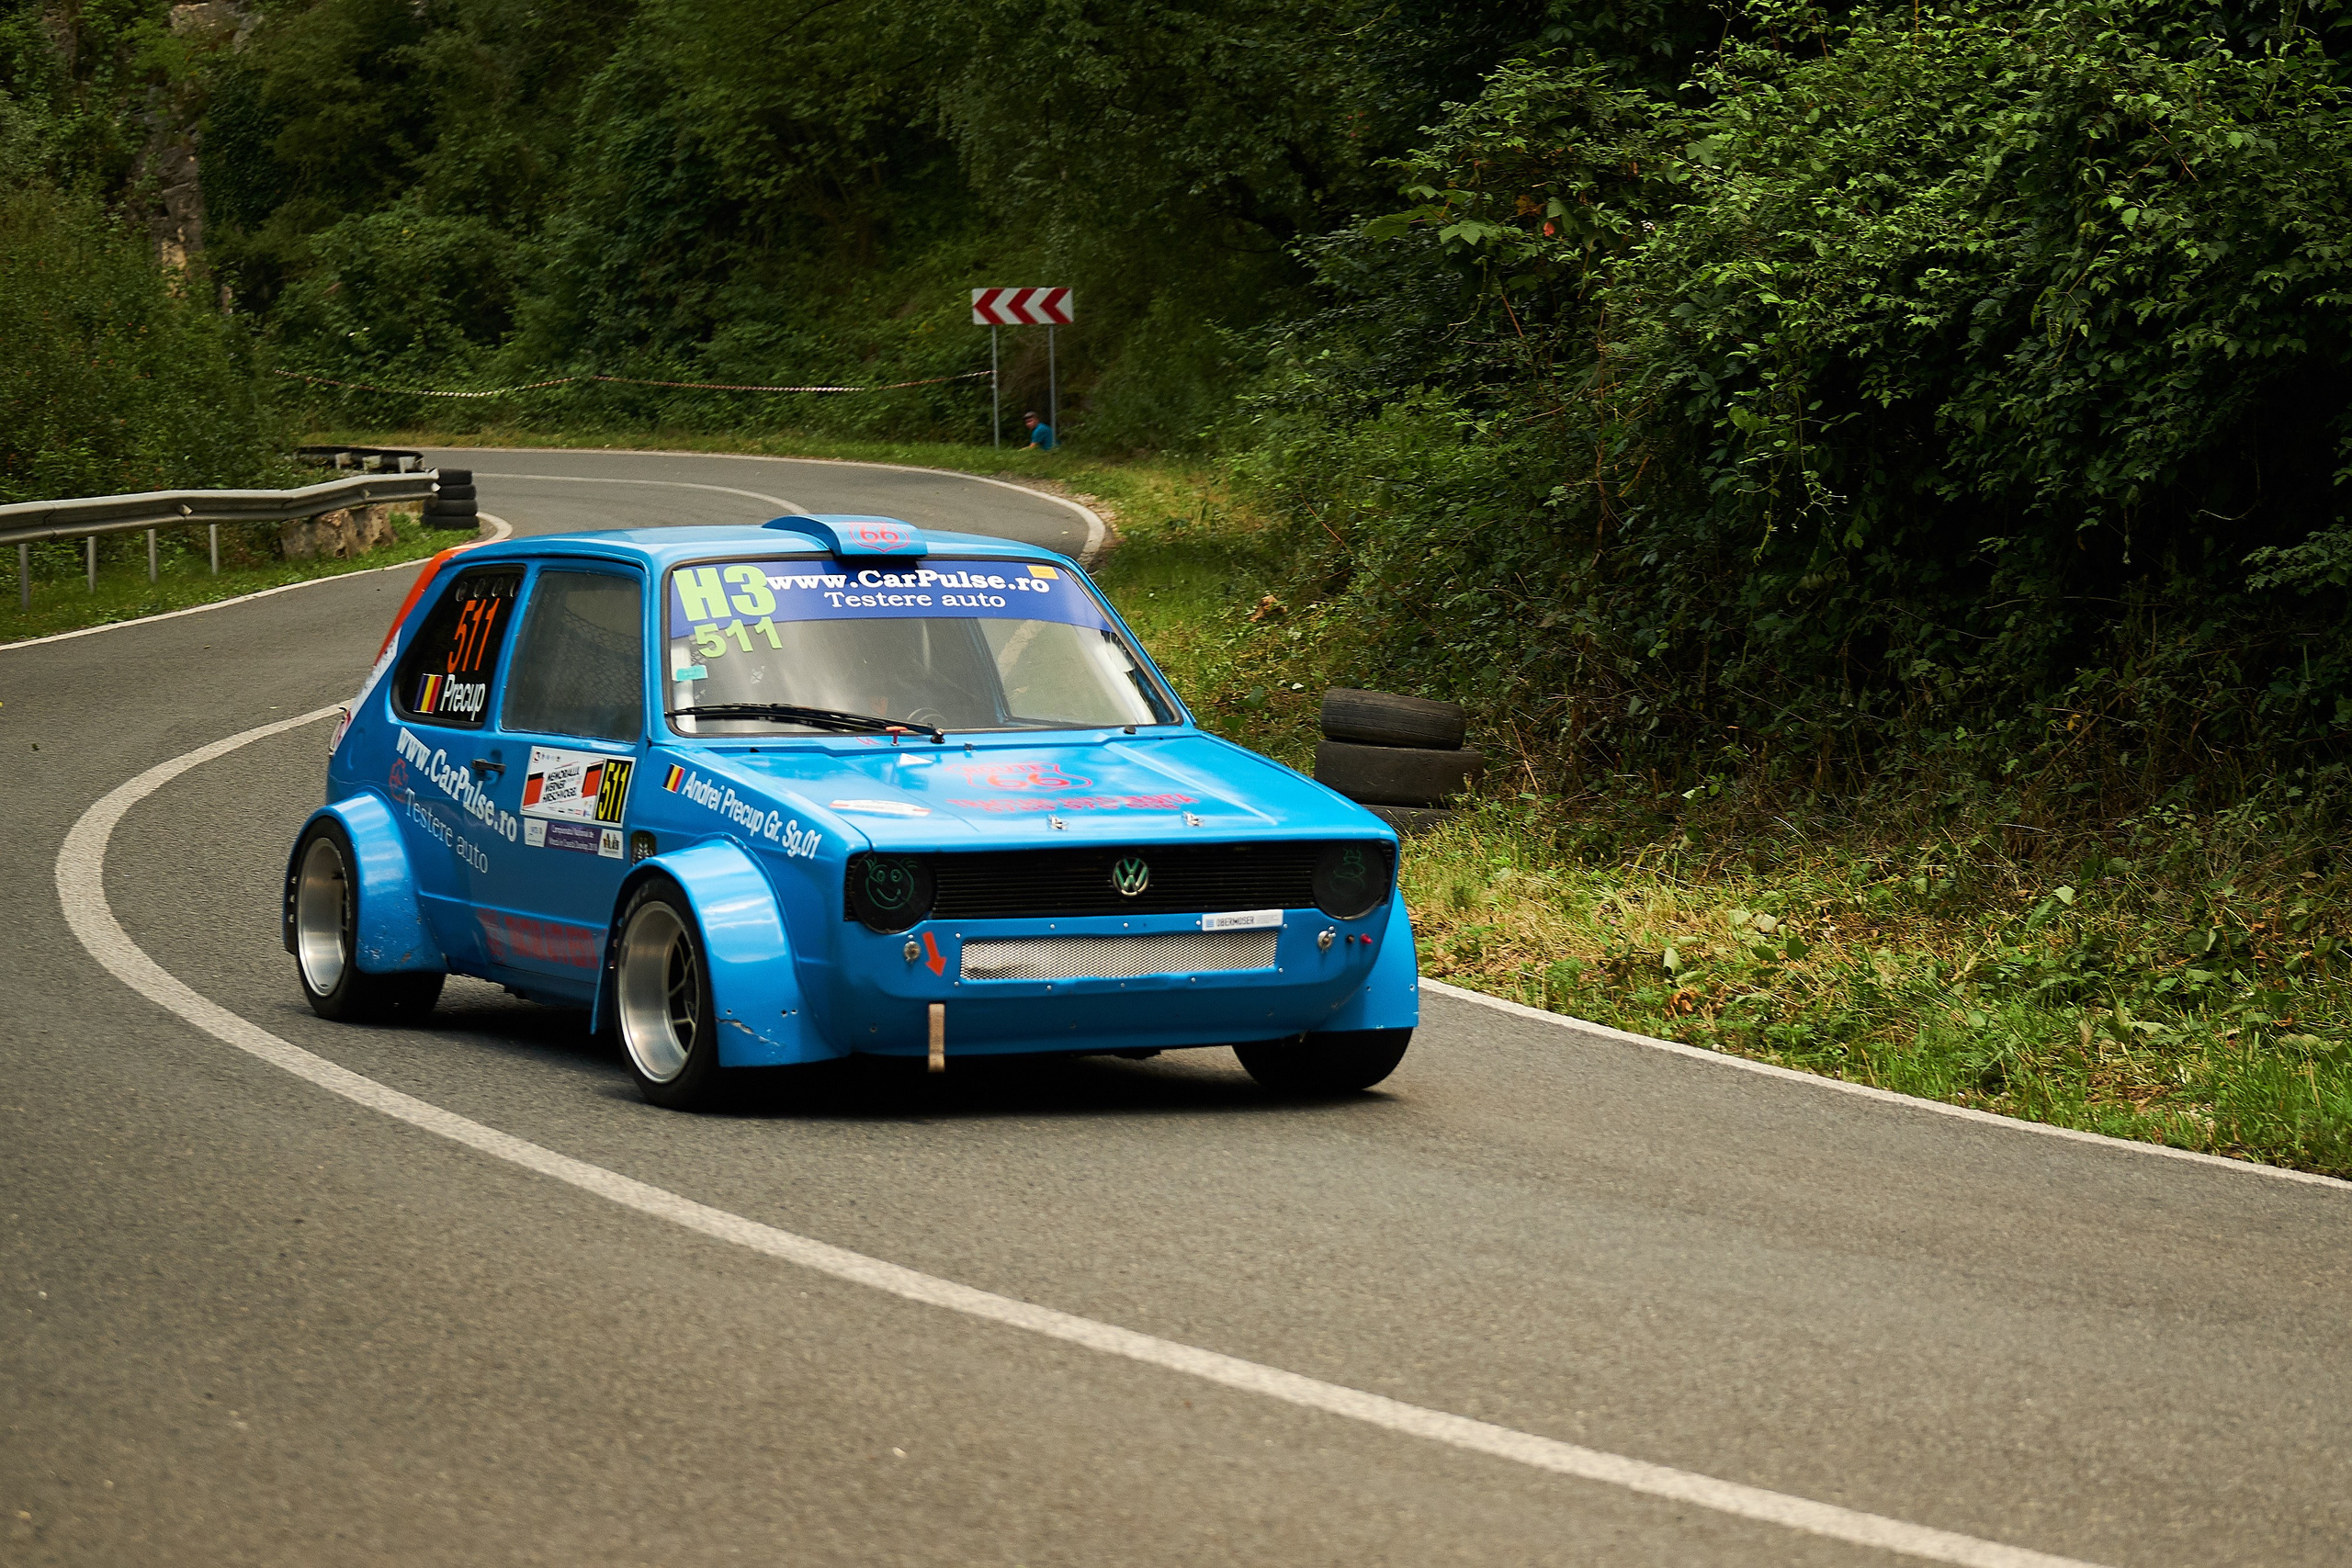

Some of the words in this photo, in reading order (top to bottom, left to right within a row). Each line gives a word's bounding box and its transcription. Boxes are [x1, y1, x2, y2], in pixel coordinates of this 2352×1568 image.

[860, 525, 899, 544] 66
[673, 565, 777, 622] H3
[764, 570, 1050, 593] www.CarPulse.ro
[824, 591, 933, 608] Testere
[941, 592, 1006, 609] auto
[447, 597, 501, 673] 511
[694, 616, 783, 658] 511
[439, 673, 485, 721] Precup
[396, 727, 517, 842] www.CarPulse.ro
[598, 762, 629, 821] 511
[987, 773, 1070, 788] 66
[404, 787, 454, 848] Testere
[456, 834, 489, 873] auto
[681, 771, 725, 812] Andrei
[719, 788, 764, 837] Precup
[763, 810, 783, 842] Gr.
[782, 819, 822, 860] Sg.01
